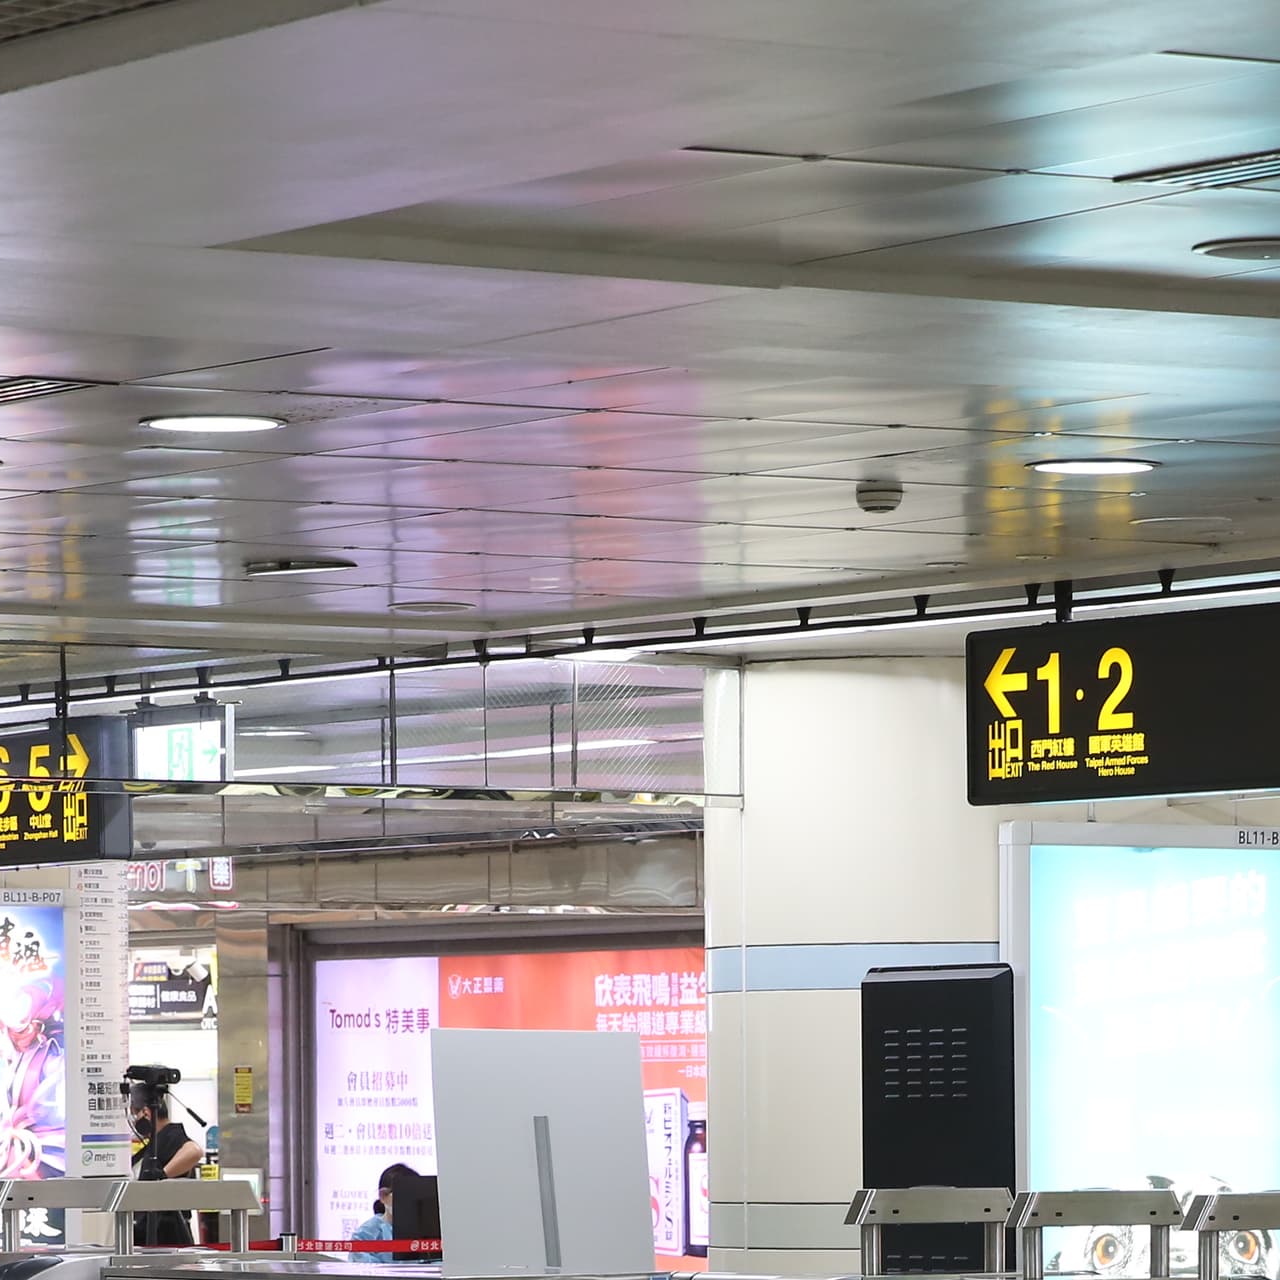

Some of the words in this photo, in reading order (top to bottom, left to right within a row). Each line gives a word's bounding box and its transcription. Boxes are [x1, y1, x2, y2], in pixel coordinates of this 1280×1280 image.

[1030, 737, 1075, 759] 西門紅樓
[1028, 762, 1040, 772] The
[1041, 761, 1055, 771] Red
[1056, 760, 1078, 770] House
[1085, 757, 1104, 769] Taipei
[1105, 757, 1126, 766] Armed
[1127, 756, 1149, 765] Forces
[1005, 762, 1024, 779] EXIT
[1098, 767, 1114, 777] Hero
[1115, 766, 1135, 776] House
[3, 892, 61, 903] BL11-B-P07
[329, 1008, 381, 1029] Tomods
[386, 1008, 430, 1034] 特美事
